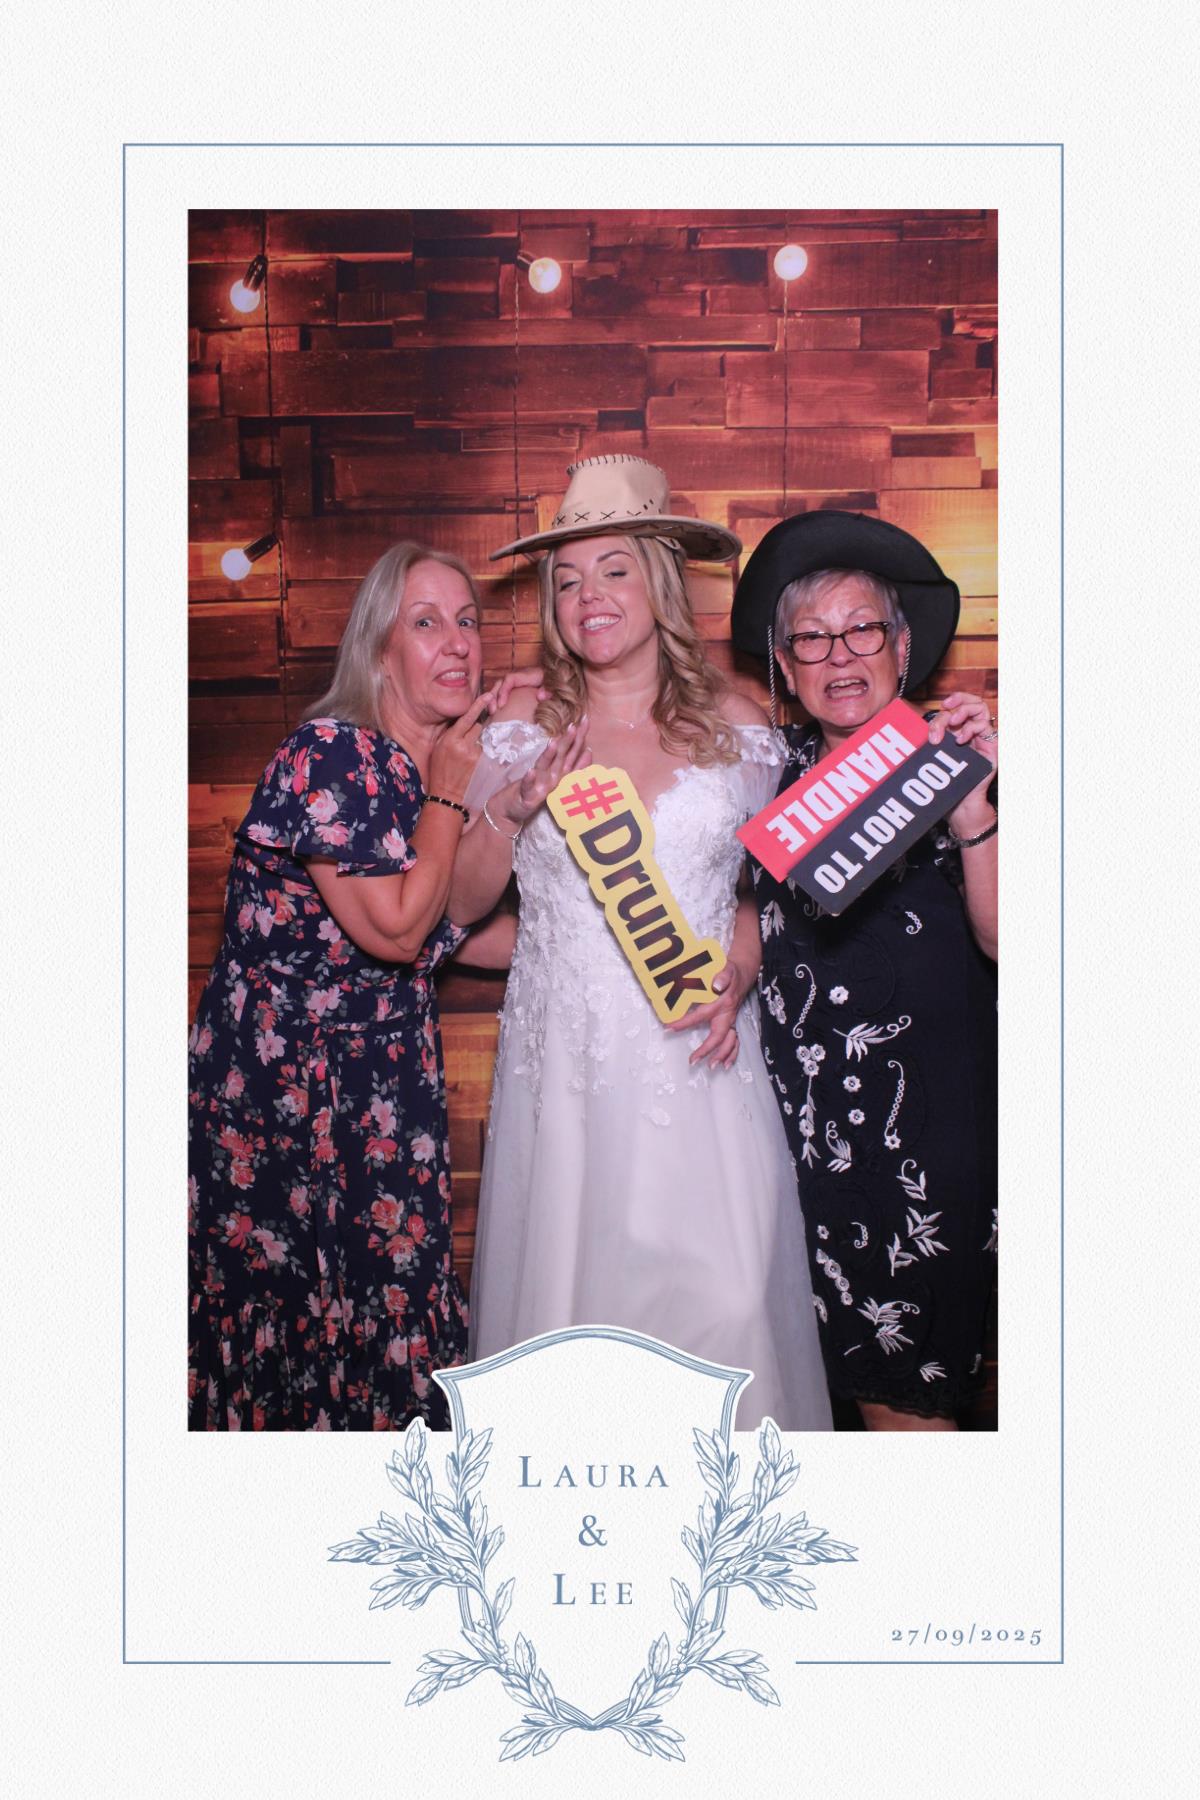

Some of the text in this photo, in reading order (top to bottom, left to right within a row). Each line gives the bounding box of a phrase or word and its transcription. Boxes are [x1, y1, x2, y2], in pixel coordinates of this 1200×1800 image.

[766, 723, 917, 854] HANDLE
[813, 750, 968, 894] TOO HOT TO
[560, 777, 713, 1011] #Drunk
